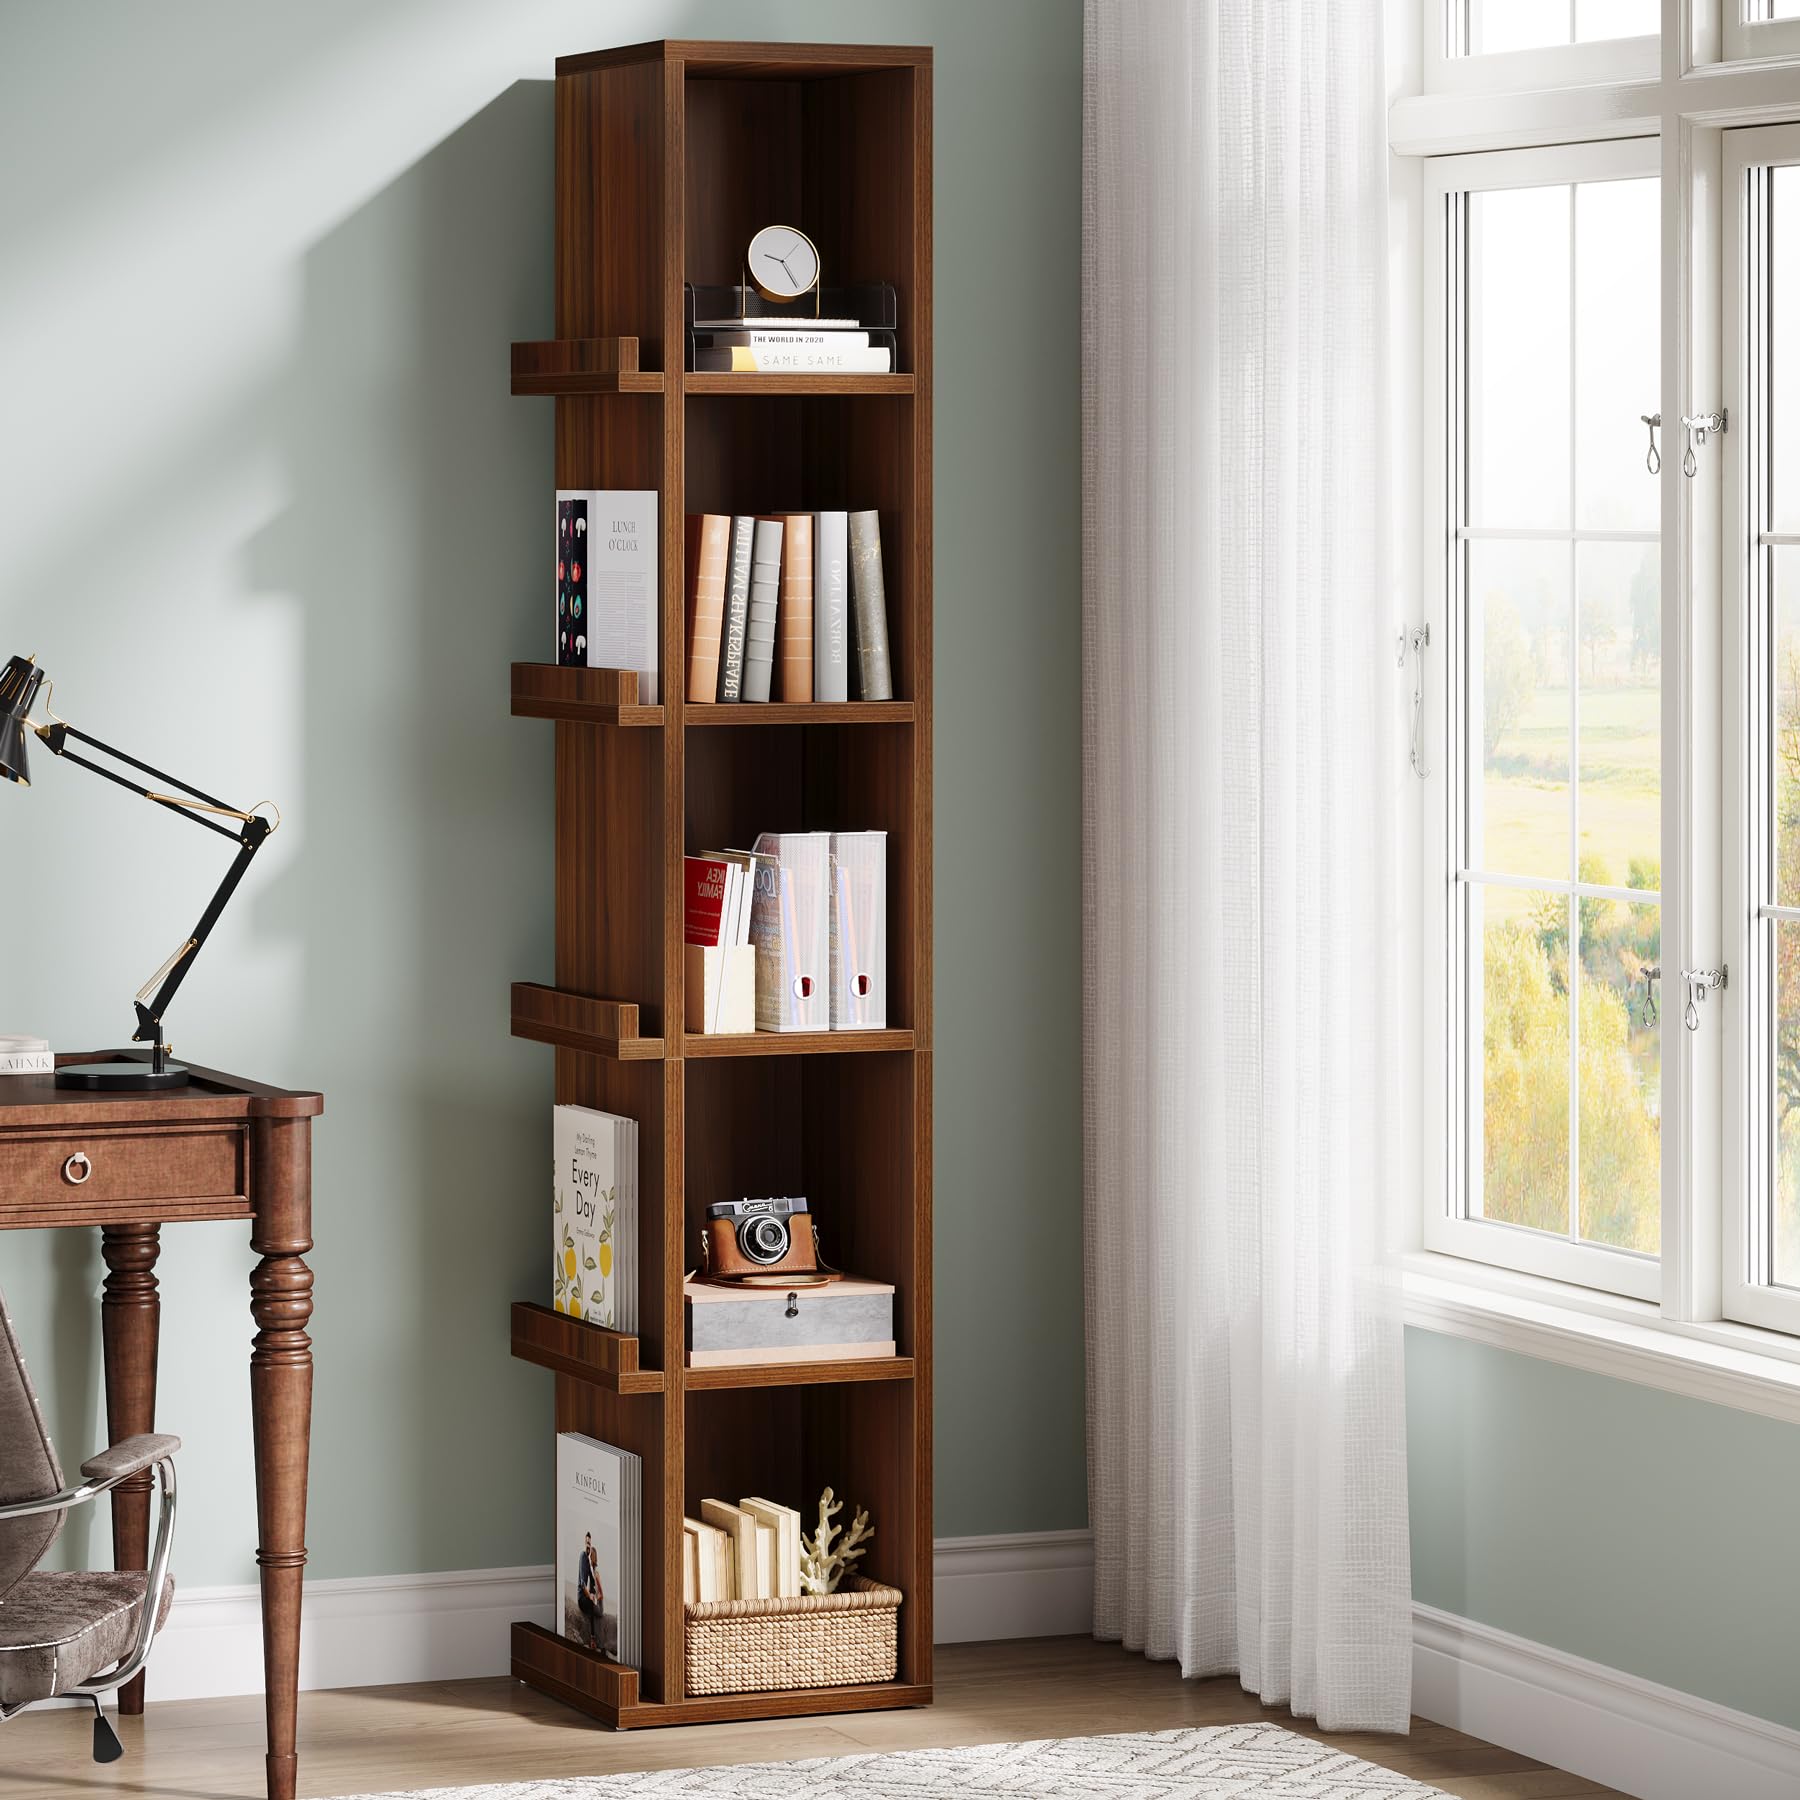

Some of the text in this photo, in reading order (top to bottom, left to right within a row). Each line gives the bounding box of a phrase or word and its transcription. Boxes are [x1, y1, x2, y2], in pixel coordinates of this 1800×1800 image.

[762, 355, 843, 366] SAME SAME
[612, 521, 636, 533] LUNCH
[608, 539, 638, 551] O'CLOCK
[572, 1158, 600, 1198] Every
[576, 1190, 596, 1227] Day
[575, 1471, 606, 1496] KINFOLK
